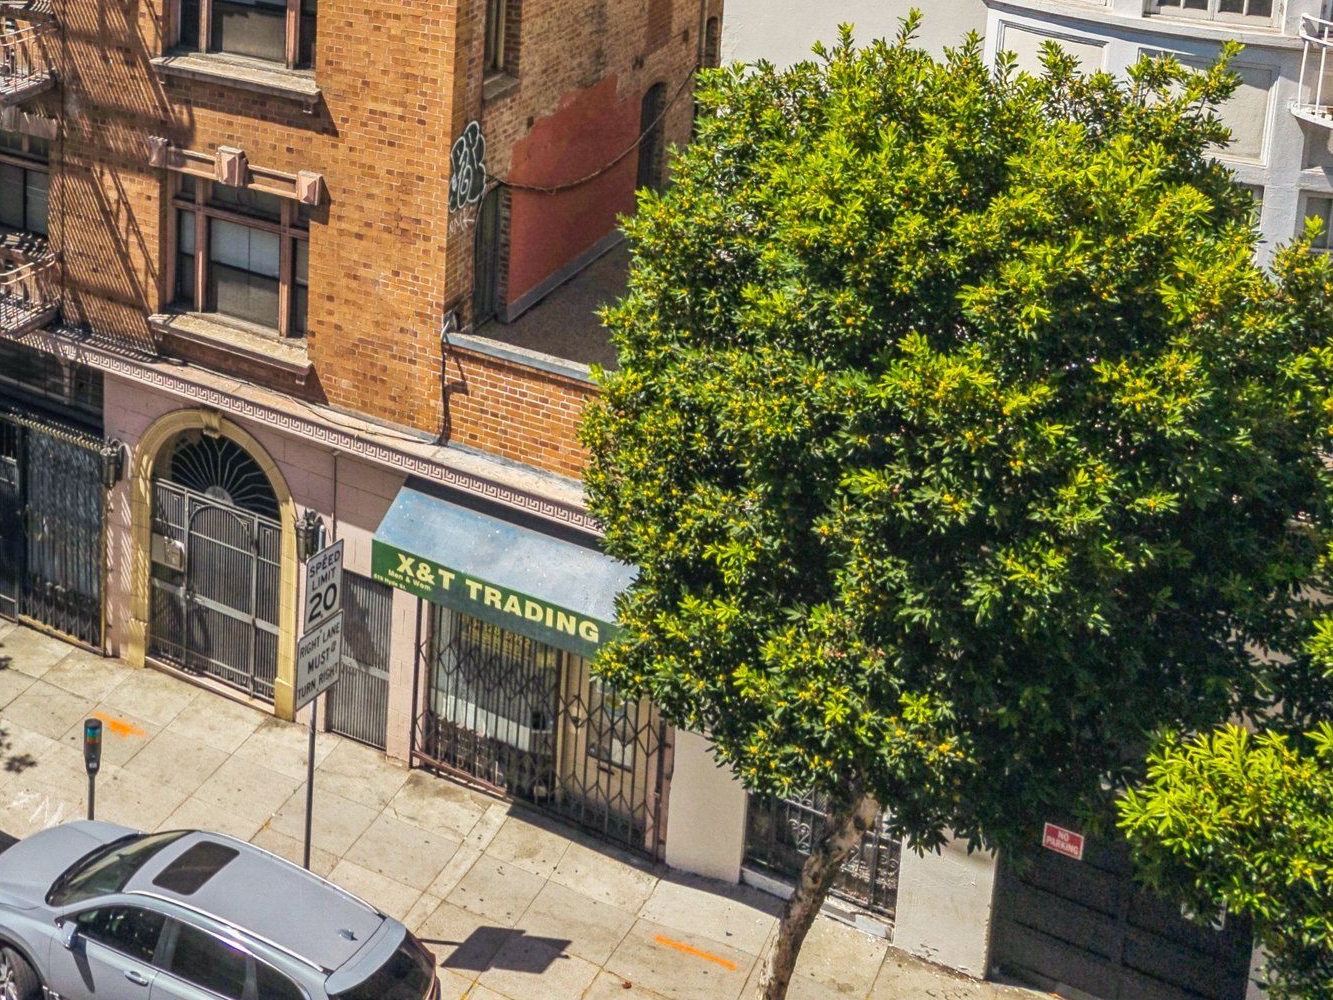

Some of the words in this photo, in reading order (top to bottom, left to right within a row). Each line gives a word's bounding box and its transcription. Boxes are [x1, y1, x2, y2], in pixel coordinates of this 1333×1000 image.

[309, 550, 340, 578] SPEED
[388, 569, 403, 580] Men
[405, 575, 411, 583] &
[312, 566, 336, 591] LIMIT
[384, 577, 398, 587] Hyde
[308, 582, 338, 624] 20
[397, 553, 455, 591] X&T
[465, 579, 599, 643] TRADING
[299, 634, 320, 660] RIGHT
[322, 622, 340, 643] LANE
[307, 648, 330, 674] MUST
[297, 678, 316, 700] TURN
[318, 662, 339, 685] RIGHT
[1047, 835, 1079, 855] PARKING
[1058, 830, 1070, 842] NO
